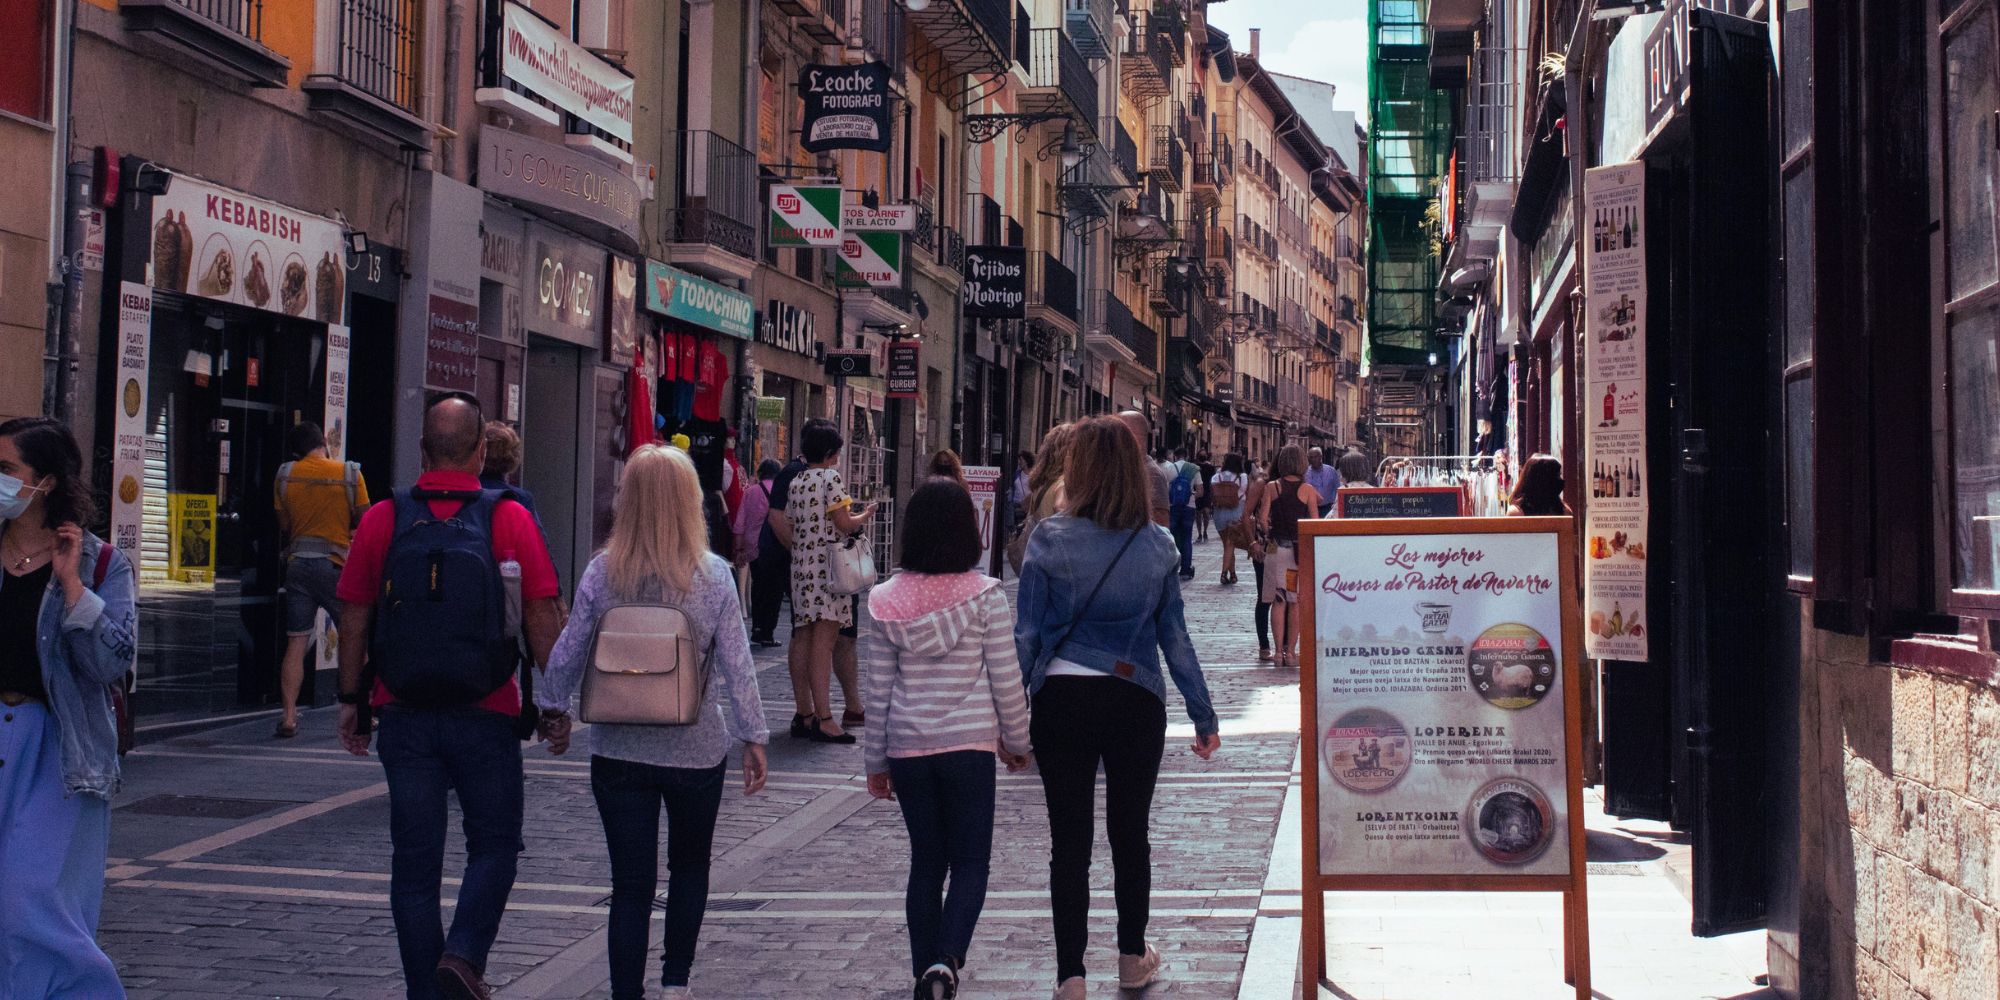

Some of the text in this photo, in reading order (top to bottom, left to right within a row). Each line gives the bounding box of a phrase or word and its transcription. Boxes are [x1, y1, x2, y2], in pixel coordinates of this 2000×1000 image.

[1650, 3, 1690, 113] HON
[809, 70, 874, 92] Leache
[823, 94, 881, 109] FOTOGRAFO
[816, 116, 838, 126] ESTUDIO
[819, 122, 872, 132] LABORATORIO COLOR
[816, 131, 833, 139] VENTA
[845, 130, 872, 138] MATERIAL
[493, 145, 513, 177] 15
[521, 154, 578, 195] GOMEZ
[206, 194, 301, 244] KEBABISH
[867, 210, 905, 218] CARNET
[870, 218, 896, 226] ACTO
[367, 253, 381, 283] 13
[967, 254, 1021, 280] Tejidos
[539, 257, 593, 317] GOMEZ
[680, 278, 750, 324] TODOCHINO
[964, 282, 1023, 308] Rodrigo
[122, 294, 150, 311] KEBAB
[121, 313, 149, 324] ESTAFETA
[126, 332, 144, 344] PLATO
[328, 334, 349, 349] KEBAB
[125, 345, 144, 357] ARROZ
[122, 357, 146, 370] BASMATI
[889, 379, 917, 388] GURGUR
[330, 385, 345, 396] KEBAB
[119, 434, 142, 447] PATATAS
[120, 448, 139, 461] FRITAS
[968, 483, 994, 491] emio
[186, 499, 208, 509] OFERTA
[117, 524, 136, 537] PLATO
[1385, 543, 1485, 570] Los mejores
[1322, 571, 1553, 602] Quesos de Pastor de Navarra
[1480, 639, 1522, 647] IDIAZABAL
[1416, 645, 1465, 656] GASNA
[1521, 652, 1546, 660] Gasna
[1369, 658, 1392, 666] (VALLE
[1350, 668, 1369, 676] Mejor
[1426, 667, 1449, 675] España
[1333, 677, 1352, 686] Mejor
[1375, 677, 1393, 685] oveja
[1423, 676, 1449, 684] Navarra
[1333, 687, 1351, 695] Mejor
[1415, 726, 1506, 738] LOPERENA
[1468, 749, 1485, 757] oveja
[1534, 748, 1552, 756] 2020)
[1514, 757, 1539, 765] AWARDS
